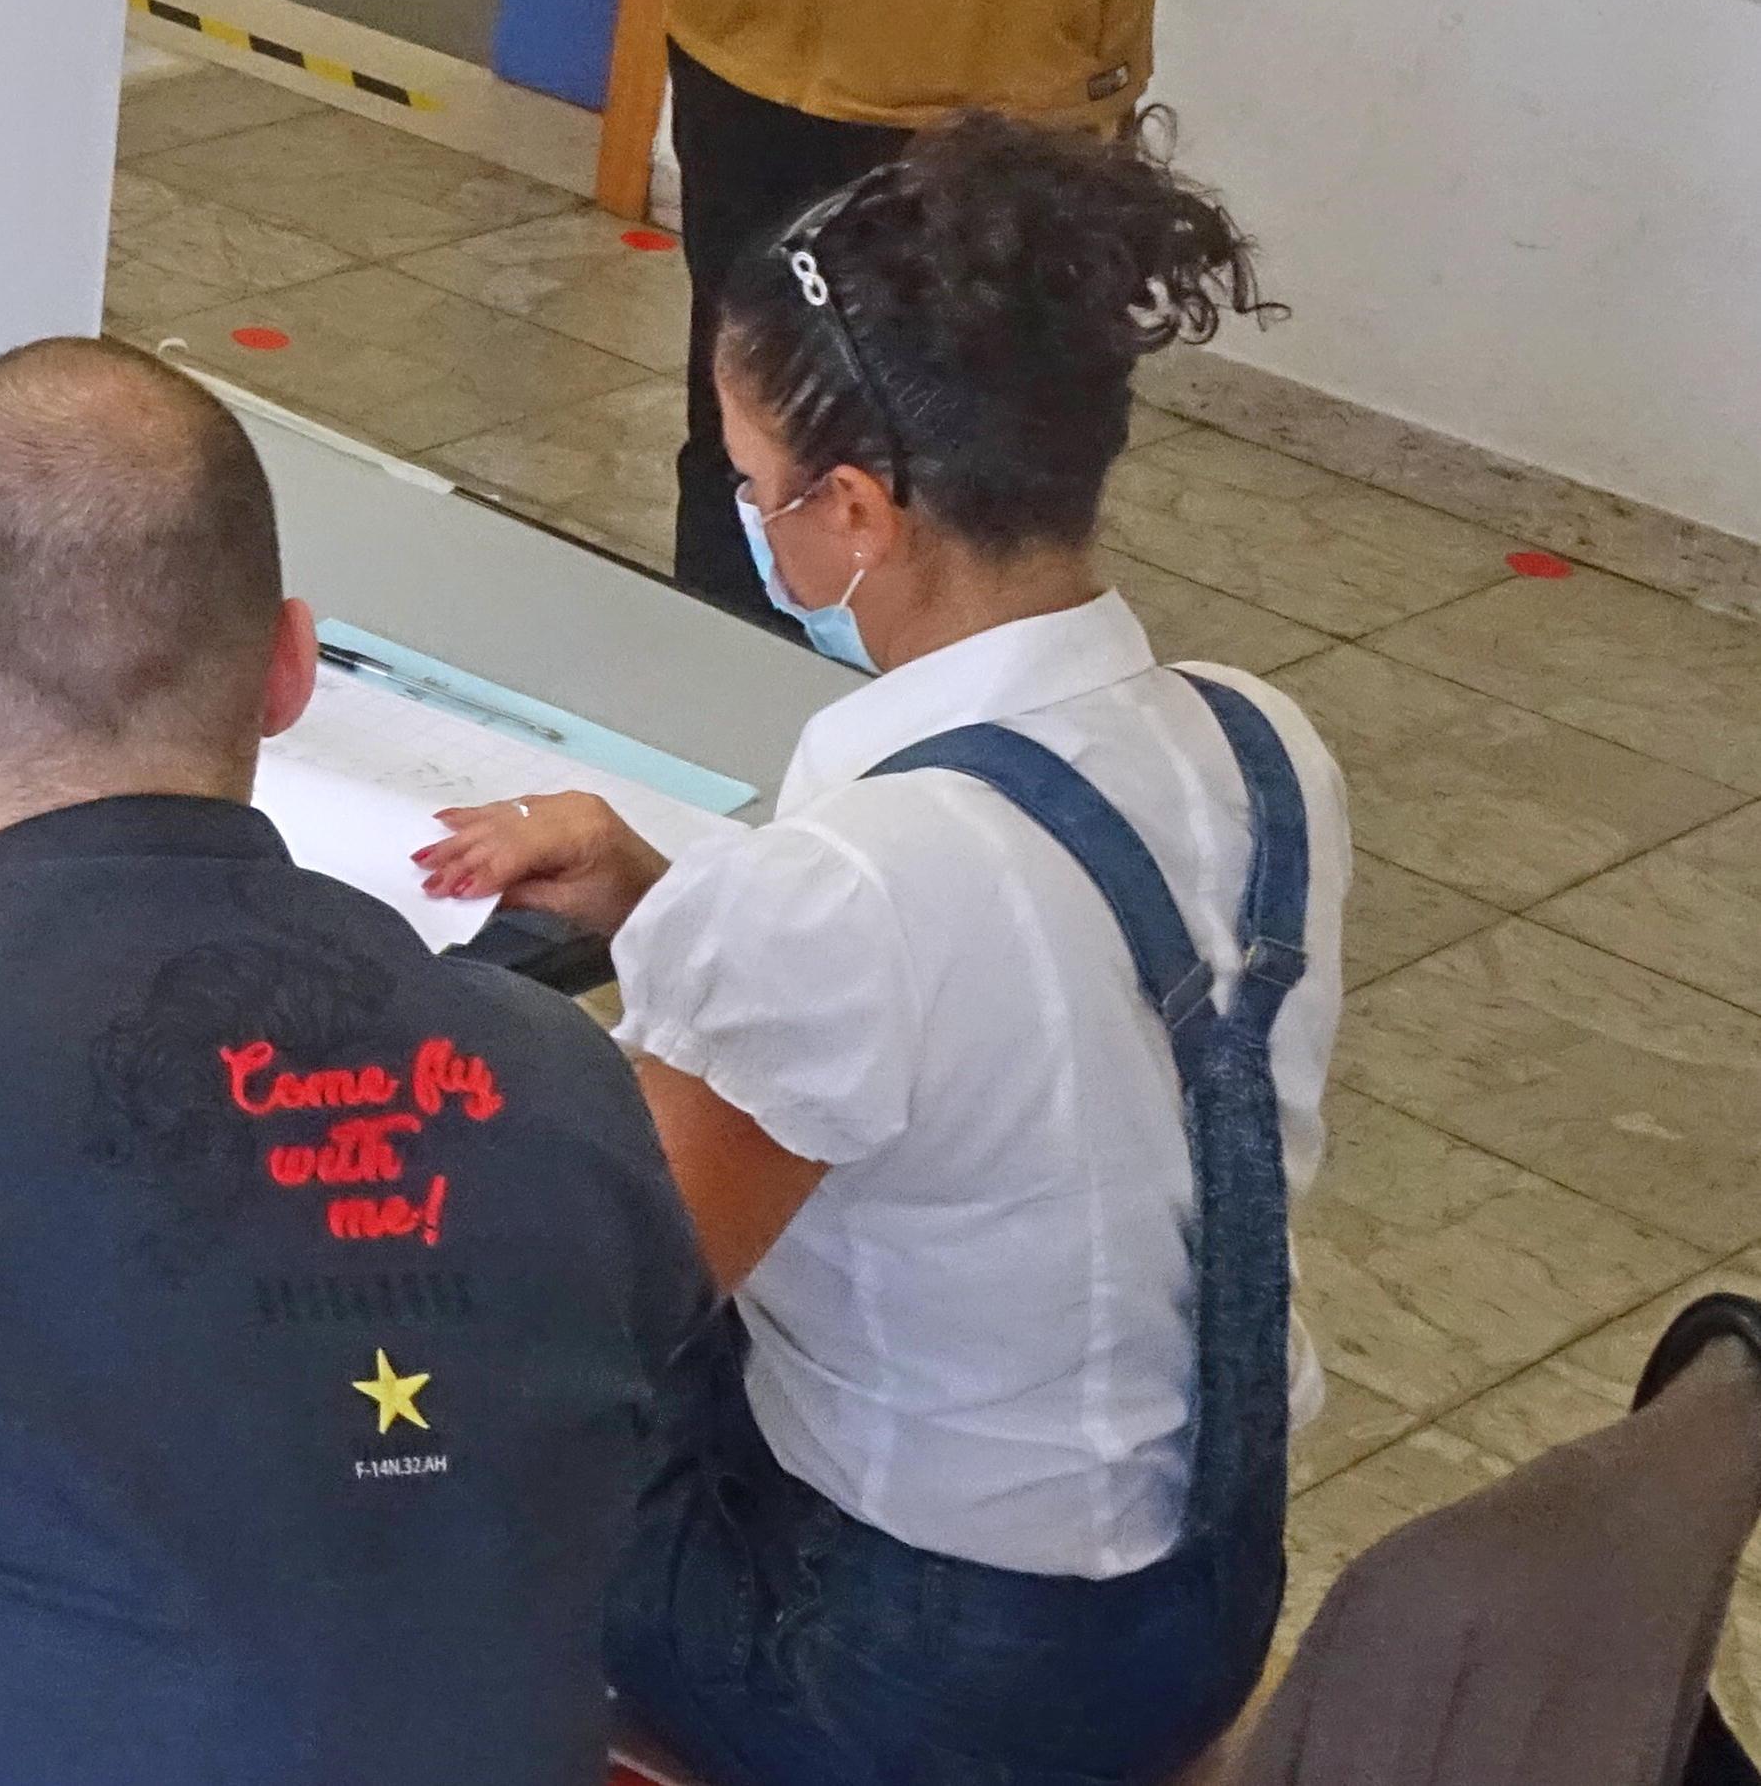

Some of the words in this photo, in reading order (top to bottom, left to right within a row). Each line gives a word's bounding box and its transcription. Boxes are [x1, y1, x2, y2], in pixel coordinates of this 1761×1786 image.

[219, 1040, 400, 1116] Come
[412, 1038, 505, 1121] fly
[268, 1112, 423, 1186] with
[326, 1174, 449, 1247] me!
